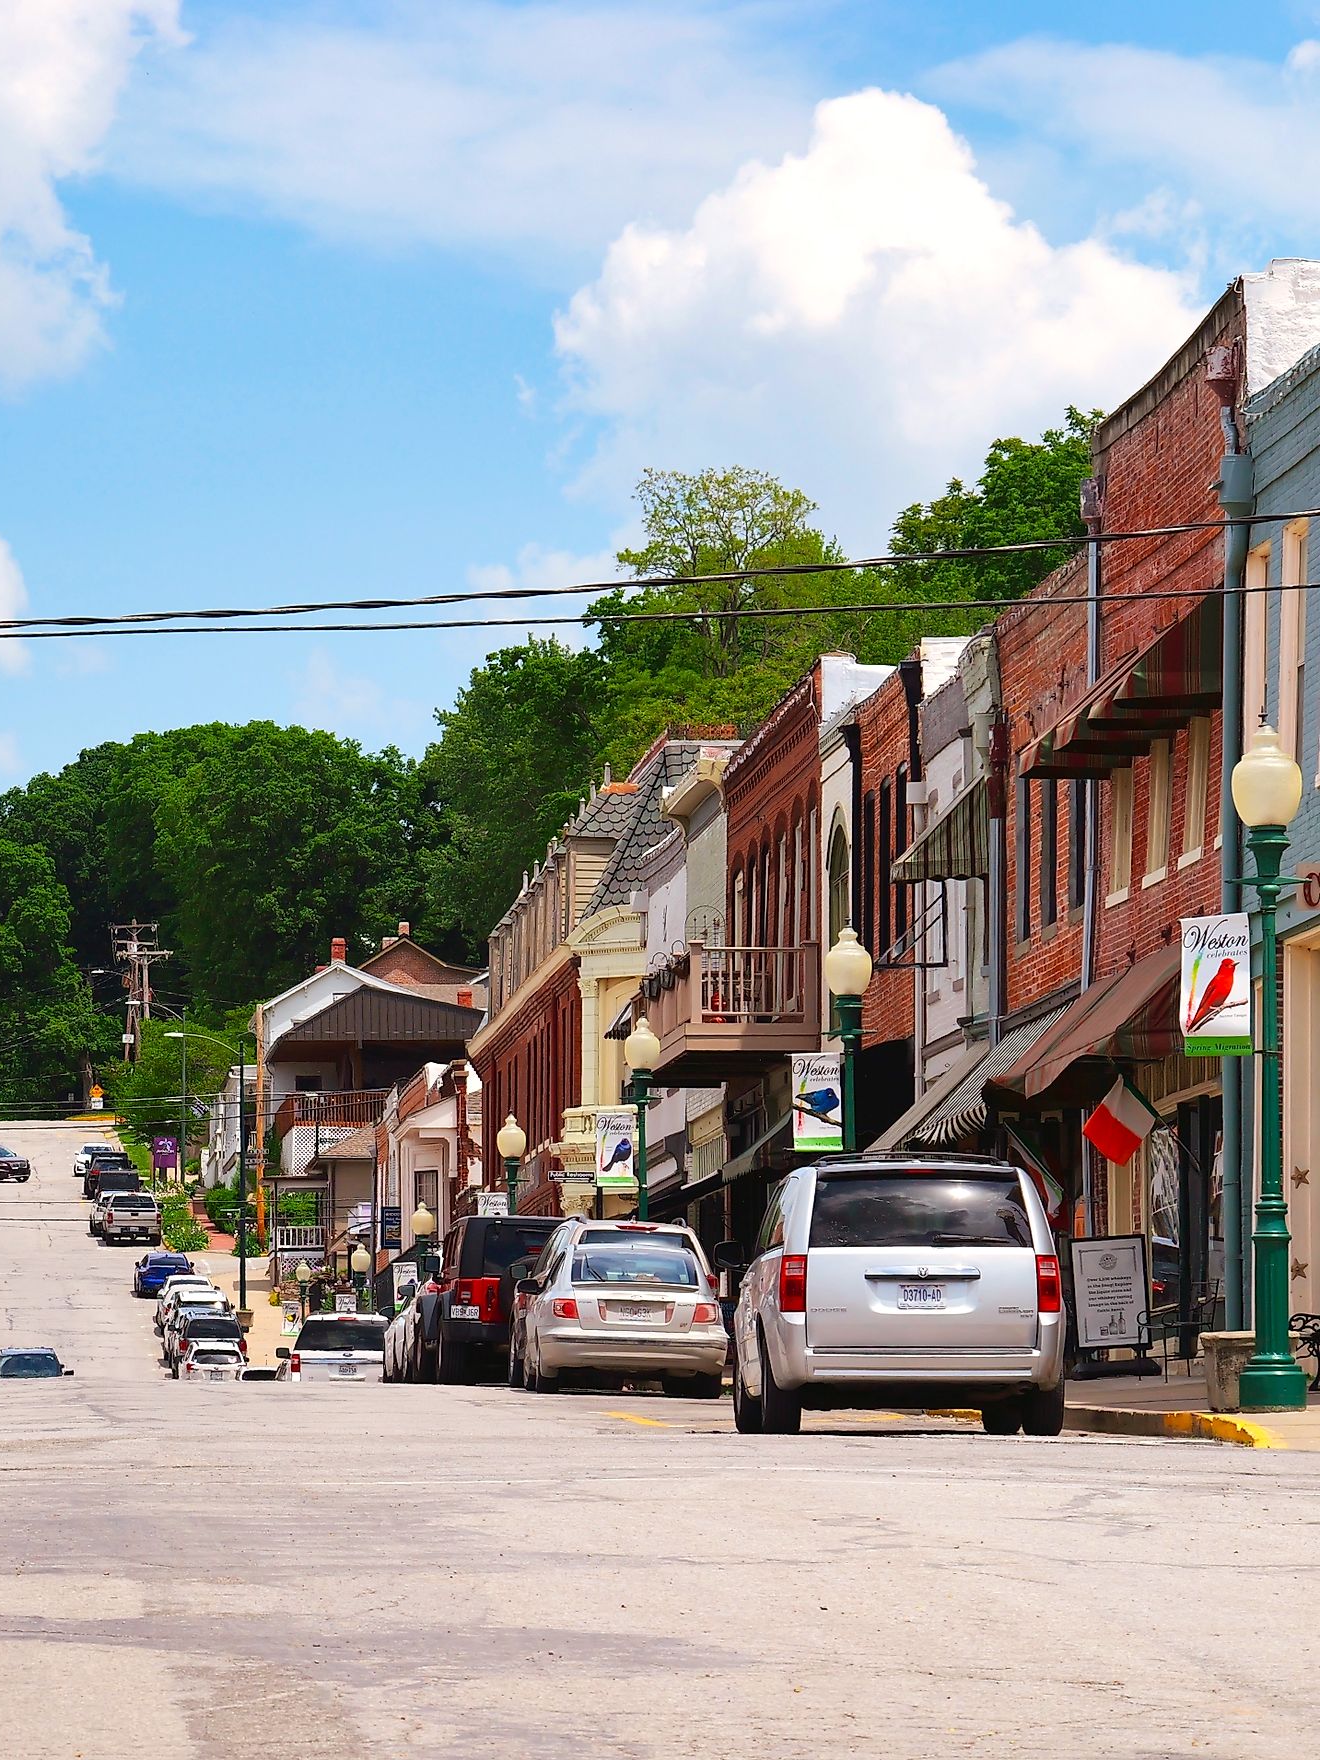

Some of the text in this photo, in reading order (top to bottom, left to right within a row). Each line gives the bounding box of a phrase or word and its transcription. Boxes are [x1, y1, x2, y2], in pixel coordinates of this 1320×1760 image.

[1183, 919, 1248, 953] Weston
[1206, 950, 1248, 959] celebrates
[1187, 1042, 1251, 1052] Spring Migration
[792, 1055, 840, 1078] Weston
[597, 1114, 632, 1131] Weston
[479, 1194, 507, 1208] Weston
[903, 1288, 941, 1302] D3710-AD
